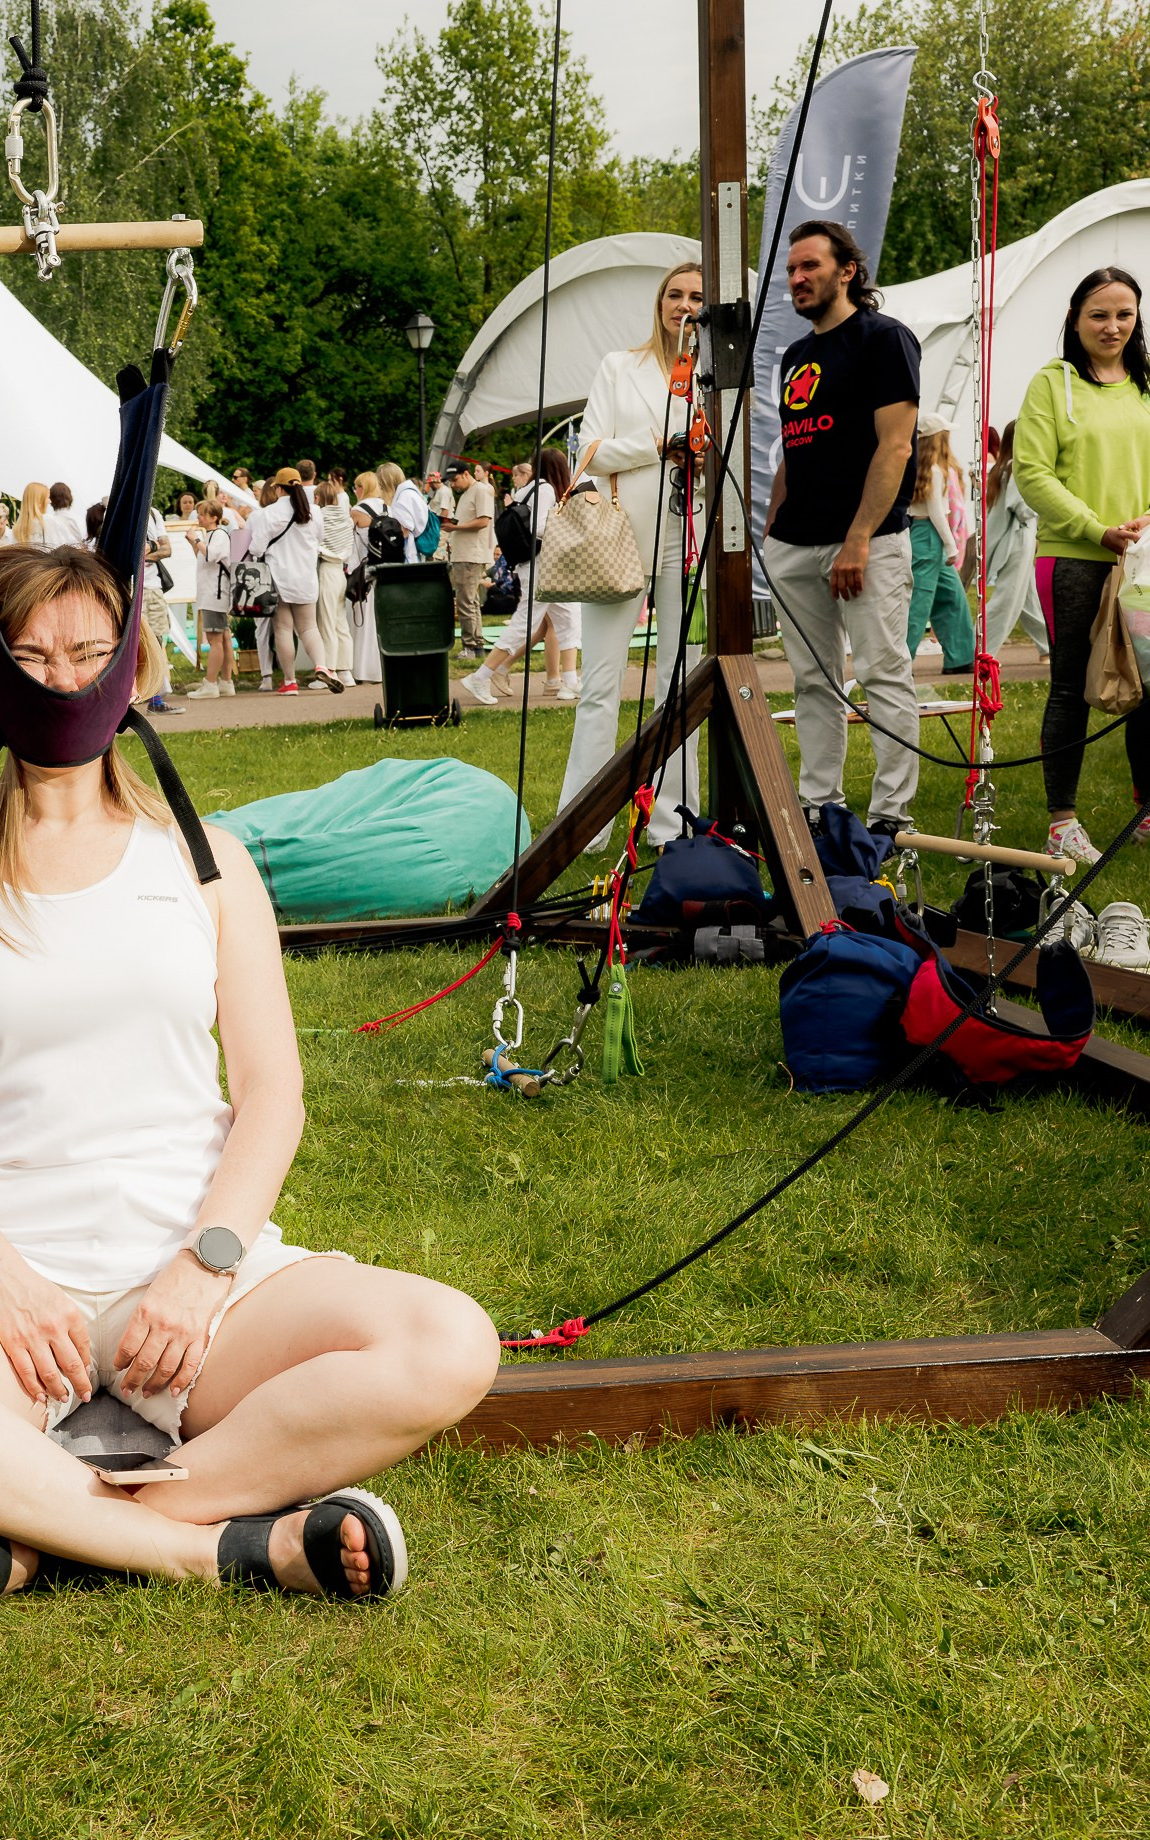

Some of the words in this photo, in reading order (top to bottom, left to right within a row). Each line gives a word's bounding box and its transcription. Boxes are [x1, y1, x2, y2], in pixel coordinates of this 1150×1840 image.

[846, 155, 867, 229] ПИТКИ
[782, 415, 834, 438] RAVILO
[785, 436, 813, 448] OSCOW
